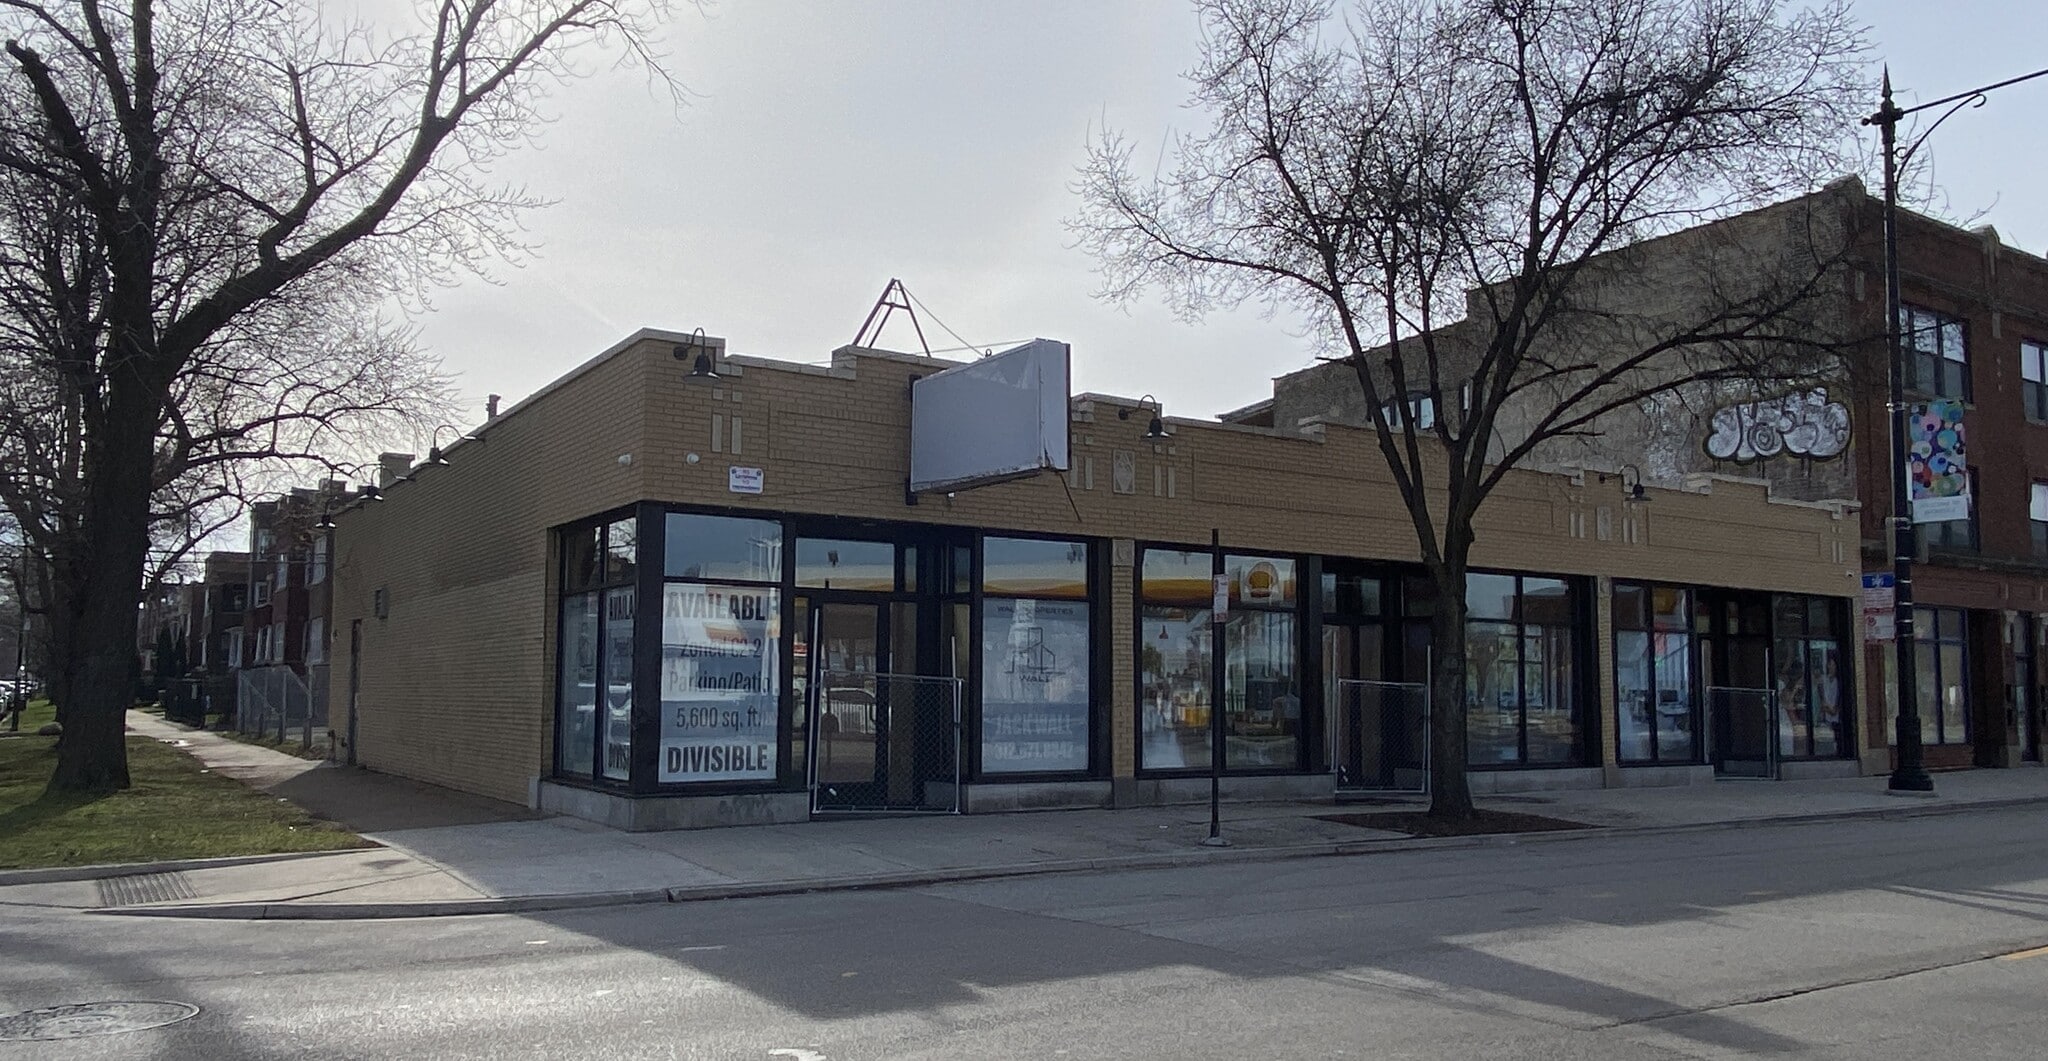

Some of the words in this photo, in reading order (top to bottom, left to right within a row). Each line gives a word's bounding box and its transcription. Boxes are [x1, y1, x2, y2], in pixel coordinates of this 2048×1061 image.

[669, 670, 771, 696] Parking/Patio
[676, 706, 718, 730] 5,600
[721, 710, 743, 732] sq.
[747, 704, 761, 728] ft.
[667, 744, 768, 774] DIVISIBLE
